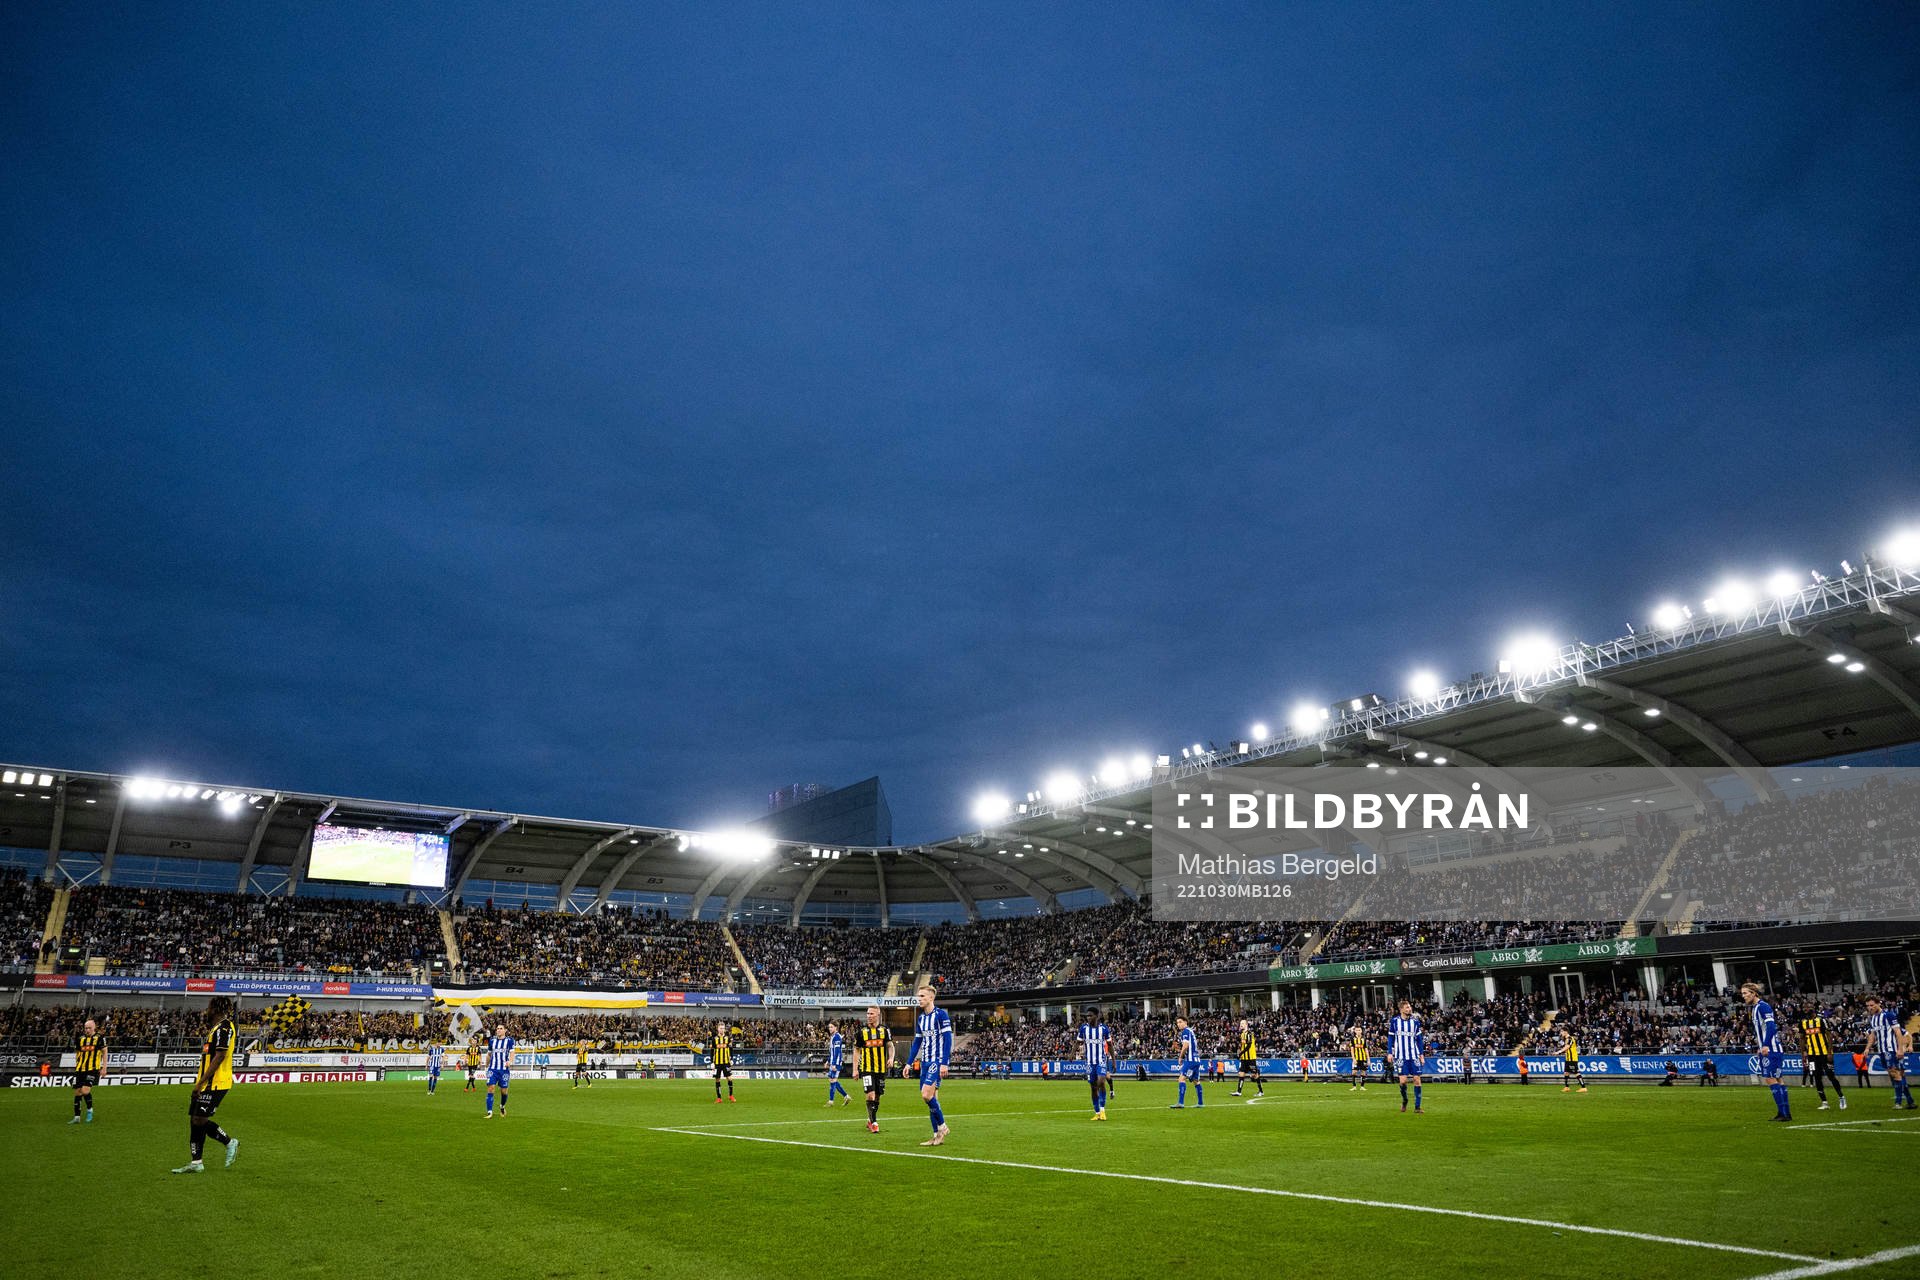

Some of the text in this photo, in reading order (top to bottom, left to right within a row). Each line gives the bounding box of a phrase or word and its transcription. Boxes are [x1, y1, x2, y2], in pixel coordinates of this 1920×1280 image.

[1422, 958, 1449, 968] Gamla
[1450, 955, 1474, 966] Ullevi
[773, 996, 815, 1005] merinfo.se
[514, 1055, 551, 1064] STENA
[1287, 1059, 1338, 1074] SENEKE
[1528, 1057, 1608, 1072] merio.se
[302, 1073, 364, 1082] CRAMO
[566, 1071, 607, 1079] TENOS
